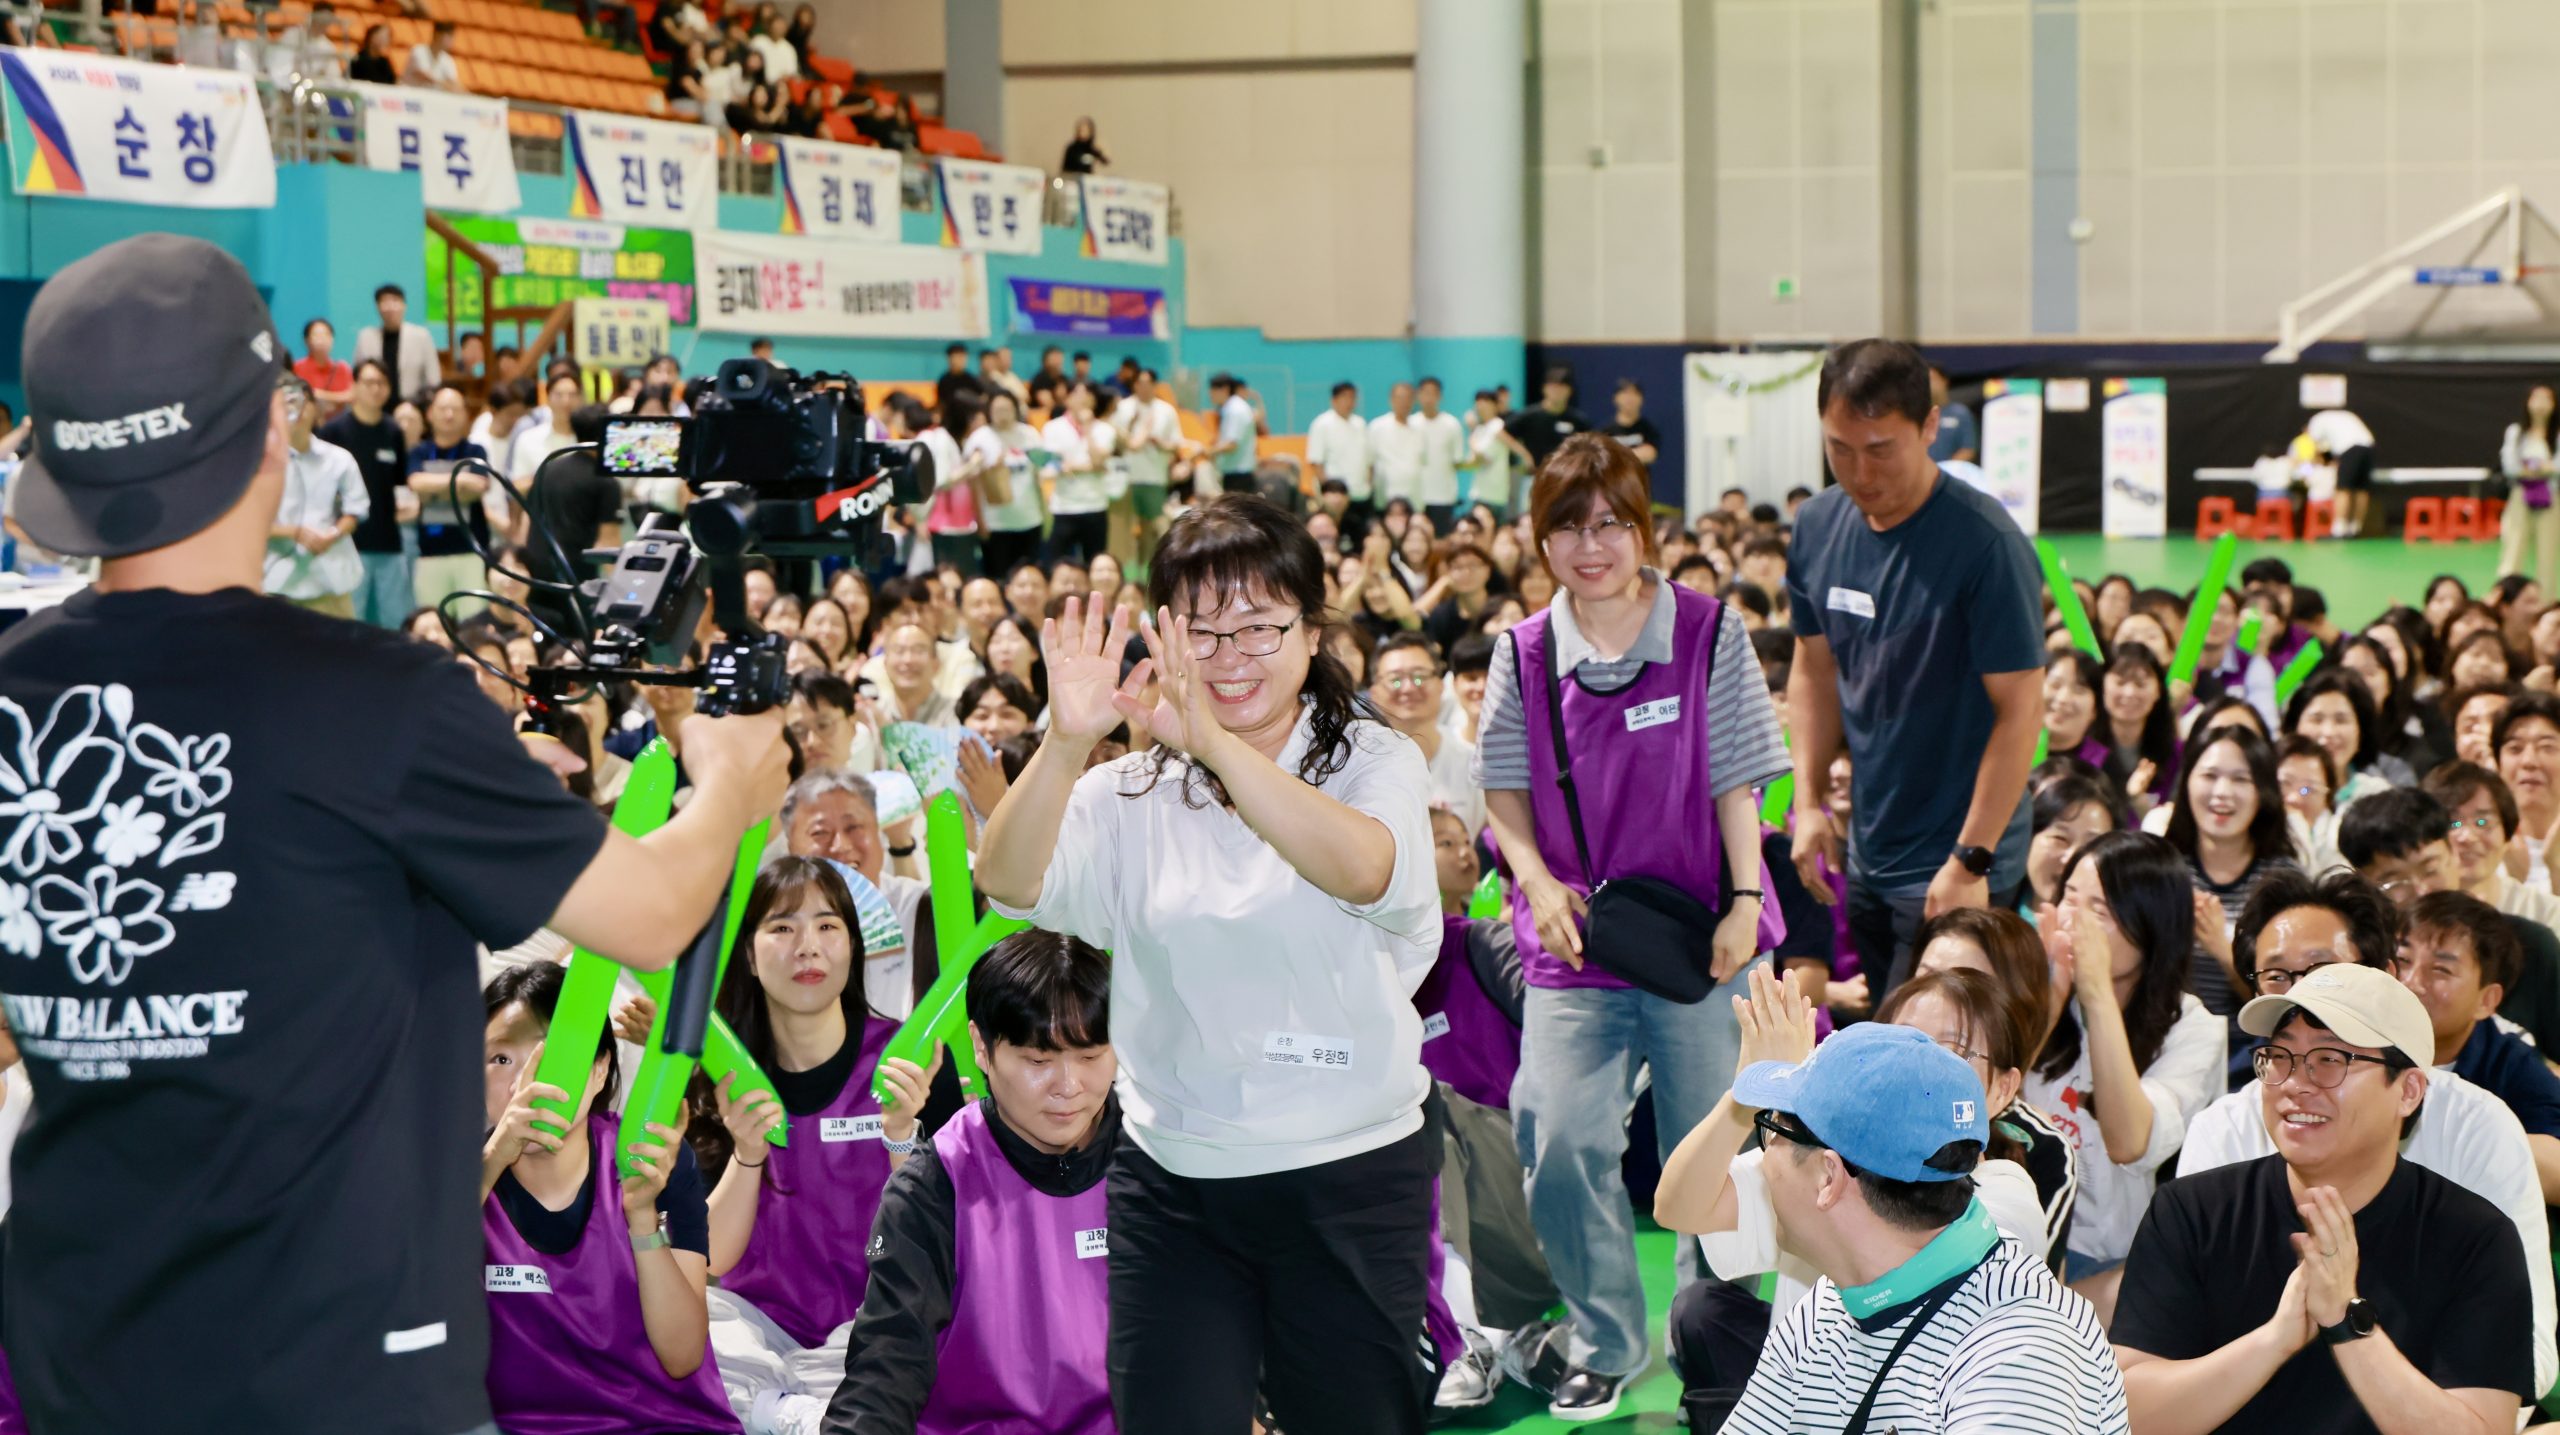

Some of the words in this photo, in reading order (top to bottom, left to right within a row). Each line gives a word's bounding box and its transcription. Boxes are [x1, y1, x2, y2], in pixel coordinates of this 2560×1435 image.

[113, 106, 217, 184] 순창
[620, 155, 683, 210] 진안
[822, 175, 875, 227] 김제
[53, 402, 191, 450] GORE-TEX
[57, 988, 248, 1040] BALANCE
[1312, 1048, 1348, 1065] 우정희
[830, 1120, 847, 1128] 고창
[1086, 1230, 1106, 1241] 고창
[495, 1267, 514, 1277] 고창
